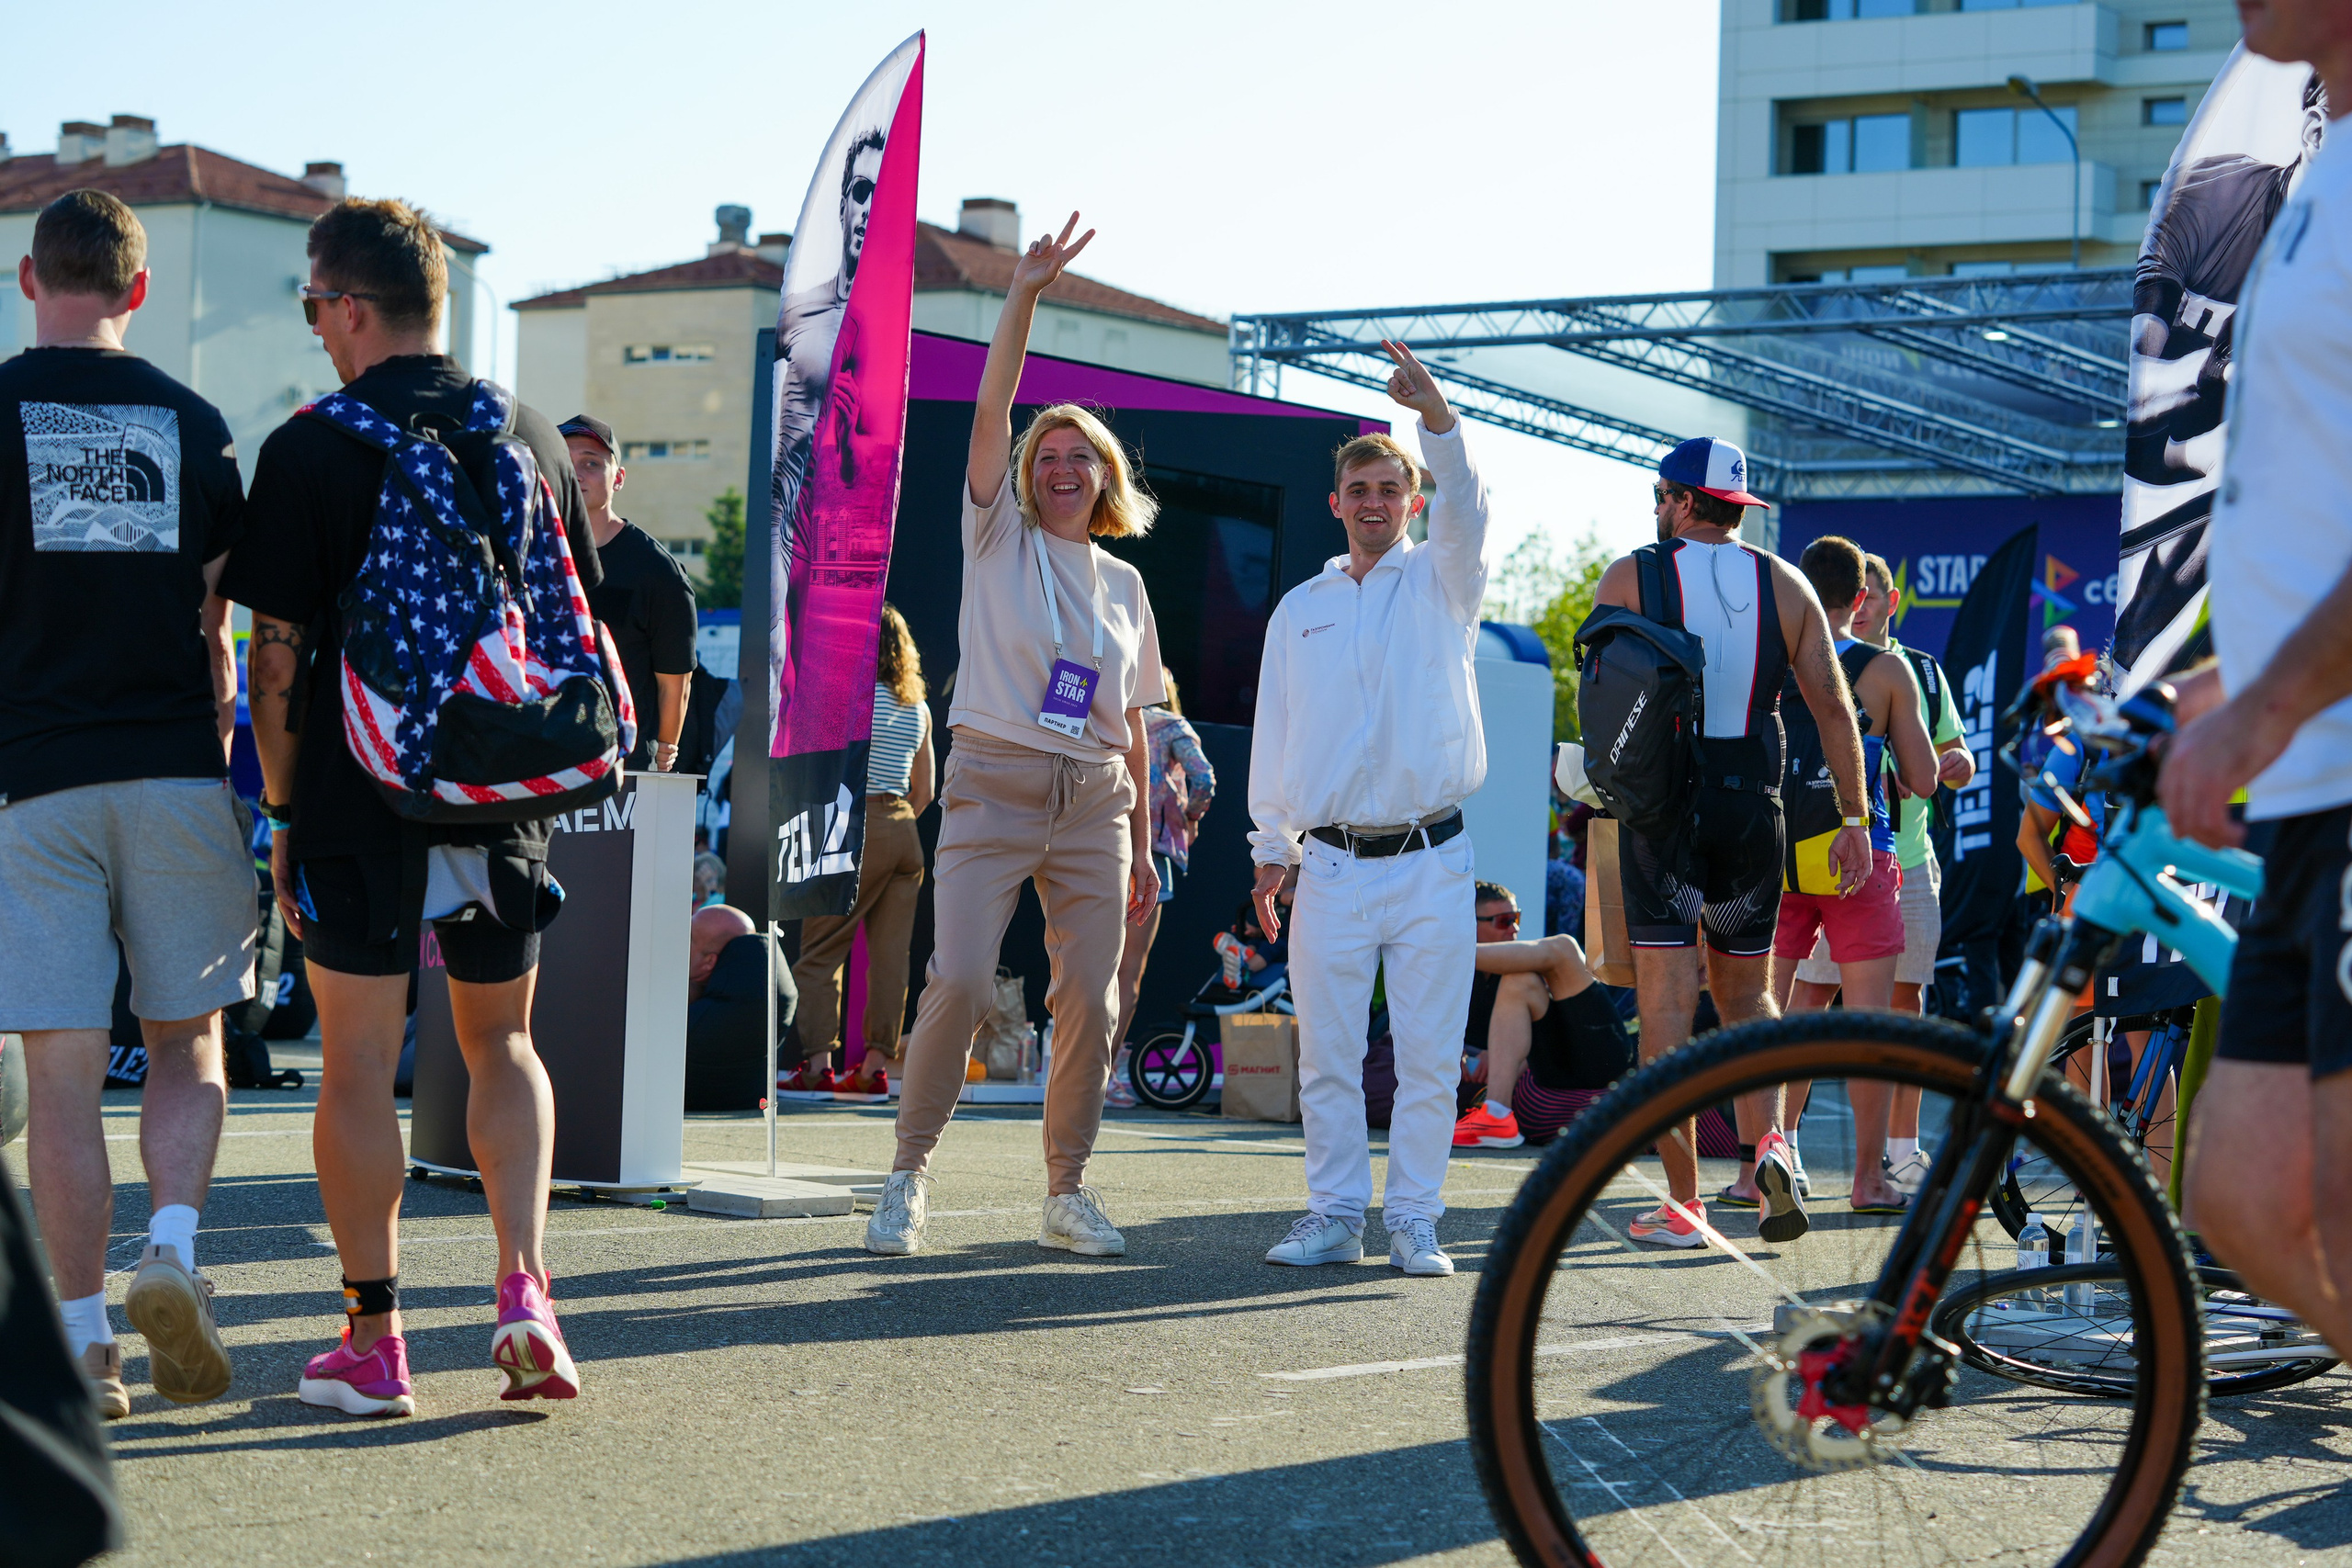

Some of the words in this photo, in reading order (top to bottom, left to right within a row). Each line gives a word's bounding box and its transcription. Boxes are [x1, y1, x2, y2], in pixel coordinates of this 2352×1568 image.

[80, 448, 123, 465] THE
[46, 463, 124, 484] NORTH
[70, 484, 125, 503] FACE
[1058, 669, 1081, 687] IRON
[1920, 659, 1938, 694] IRONSTAR
[1055, 681, 1087, 705] STAR
[1044, 716, 1068, 730] ПАРТНЕР
[1609, 690, 1648, 766] DAINESE
[1240, 1065, 1281, 1074] МАГНИТ
